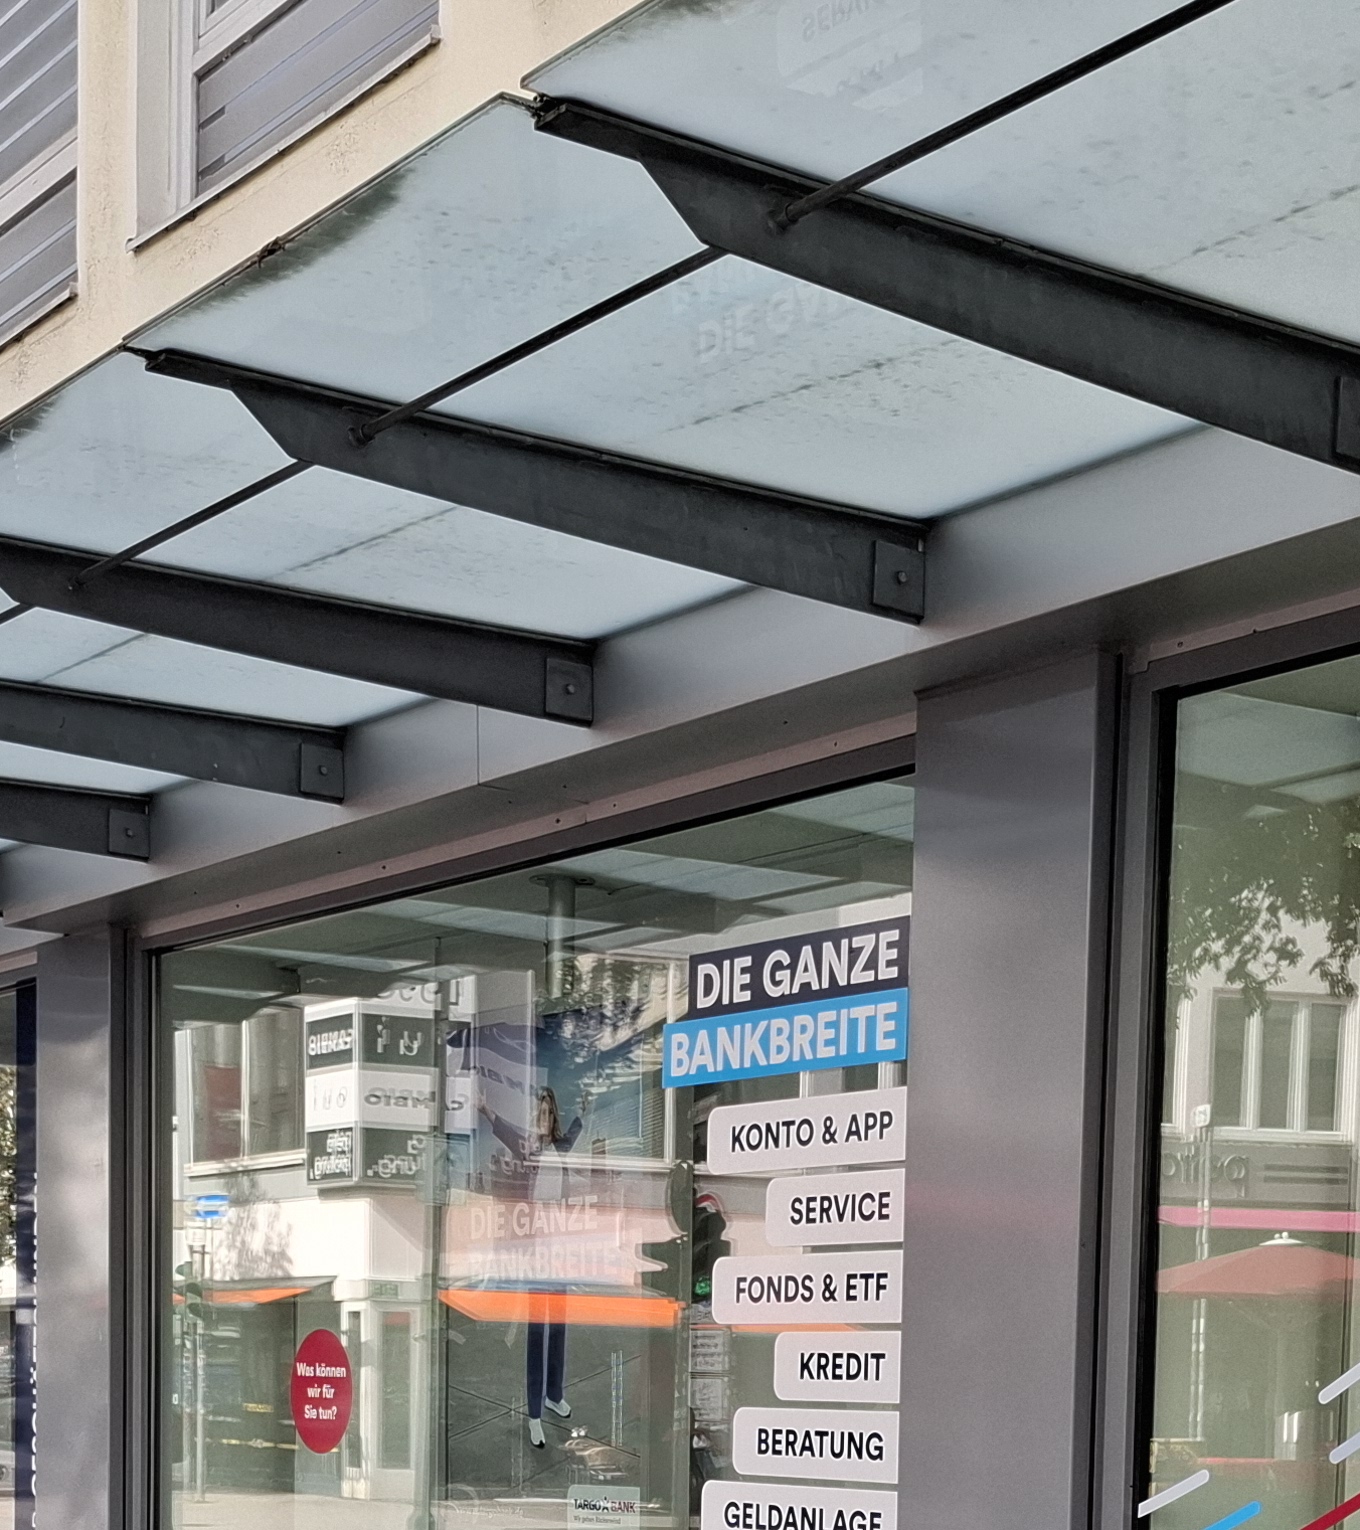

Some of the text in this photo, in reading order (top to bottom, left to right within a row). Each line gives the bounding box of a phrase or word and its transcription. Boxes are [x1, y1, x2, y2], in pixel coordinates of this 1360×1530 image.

[696, 929, 900, 1010] DIE GANZE
[670, 1002, 897, 1078] BANKBREITE
[730, 1110, 894, 1153] KONTO & APP
[470, 1195, 598, 1240] DIE GANZE
[790, 1192, 891, 1225] SERVICE
[735, 1272, 889, 1304] FONDS & ETF
[296, 1362, 346, 1378] Was können
[800, 1352, 886, 1382] KREDIT
[307, 1384, 335, 1398] wir für
[304, 1404, 337, 1420] Sie tun?
[757, 1428, 884, 1461] BERATUNG
